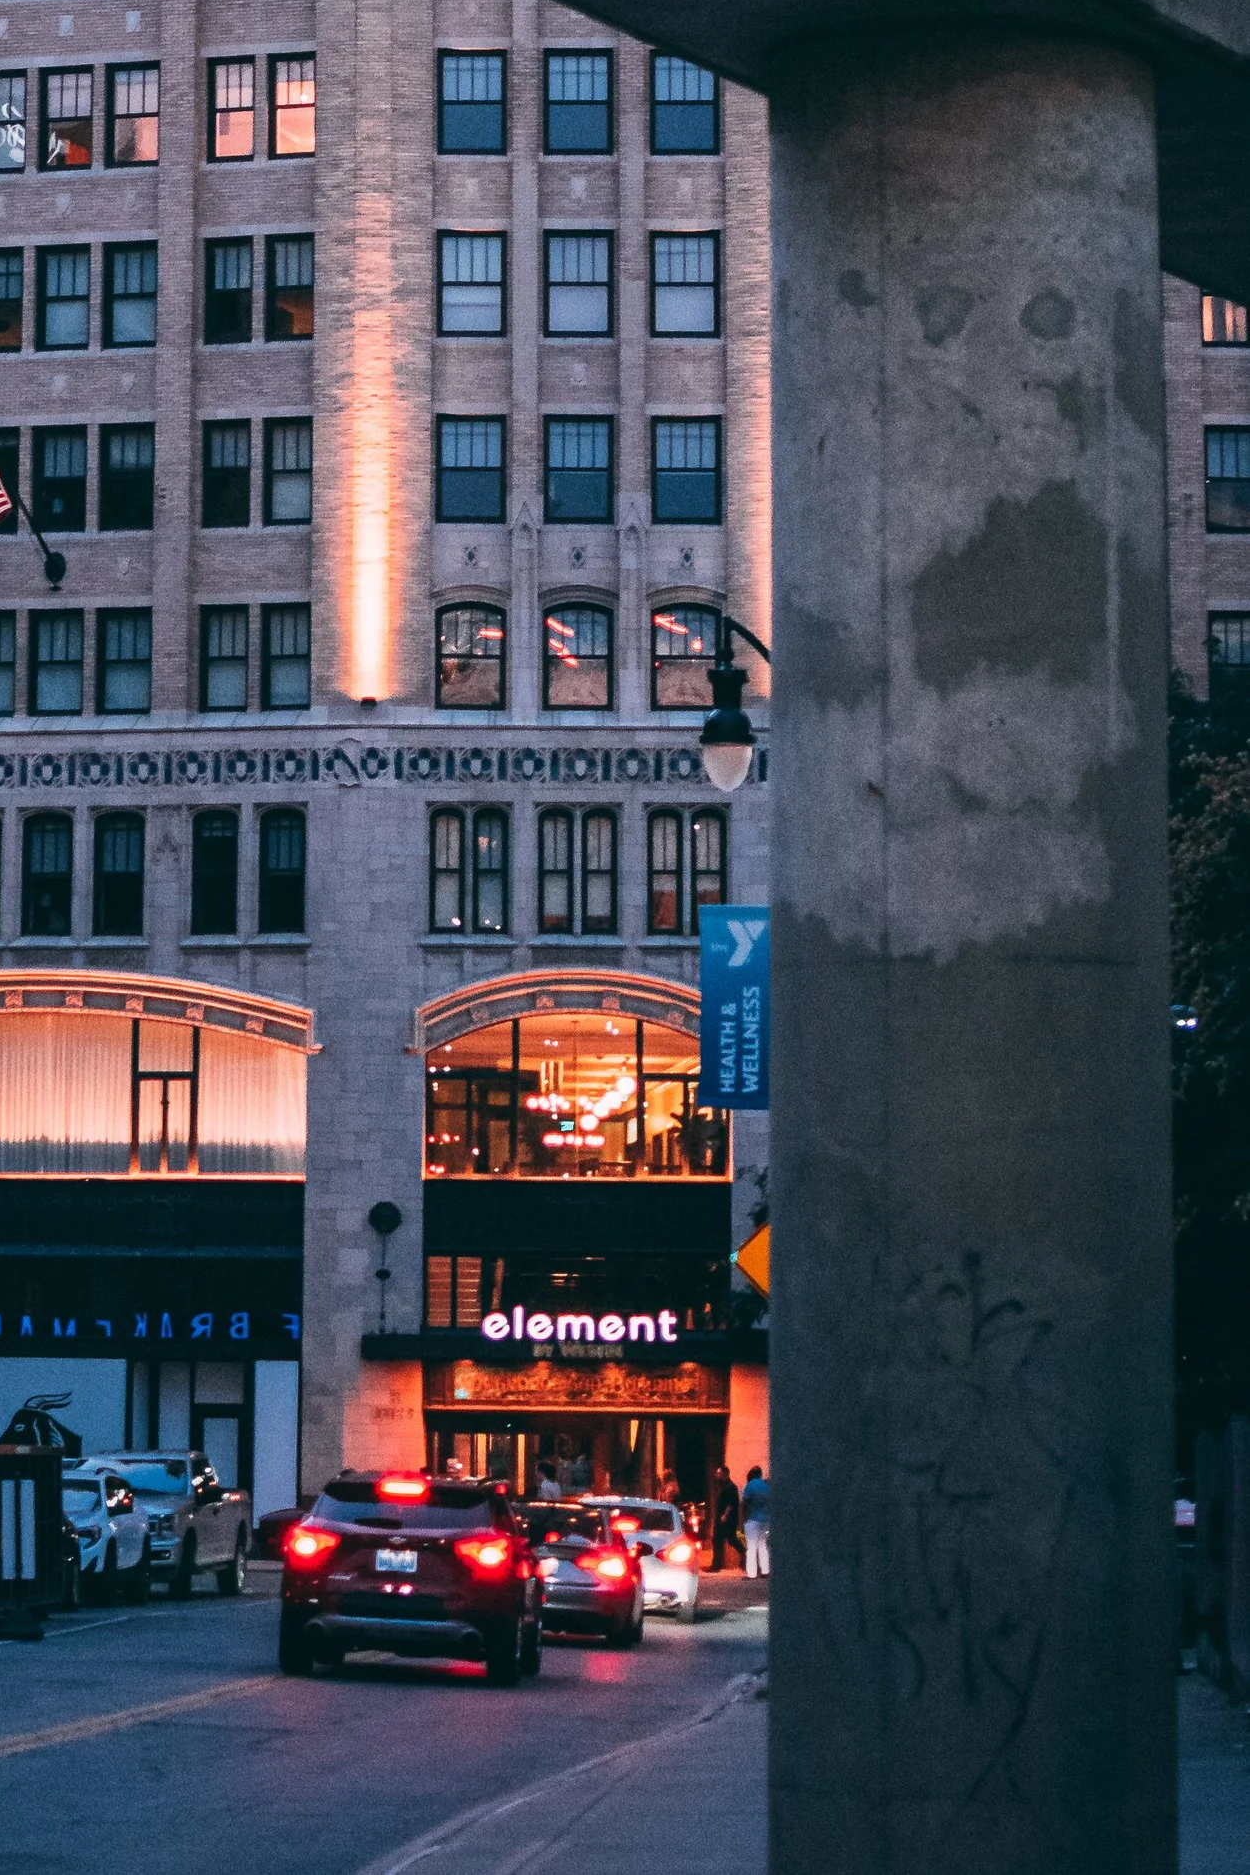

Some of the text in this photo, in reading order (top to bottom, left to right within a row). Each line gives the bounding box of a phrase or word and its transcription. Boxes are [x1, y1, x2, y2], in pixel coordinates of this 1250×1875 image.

[719, 1003, 737, 1093] HEALTH &
[742, 986, 760, 1093] WELLNESS
[482, 1305, 678, 1342] element
